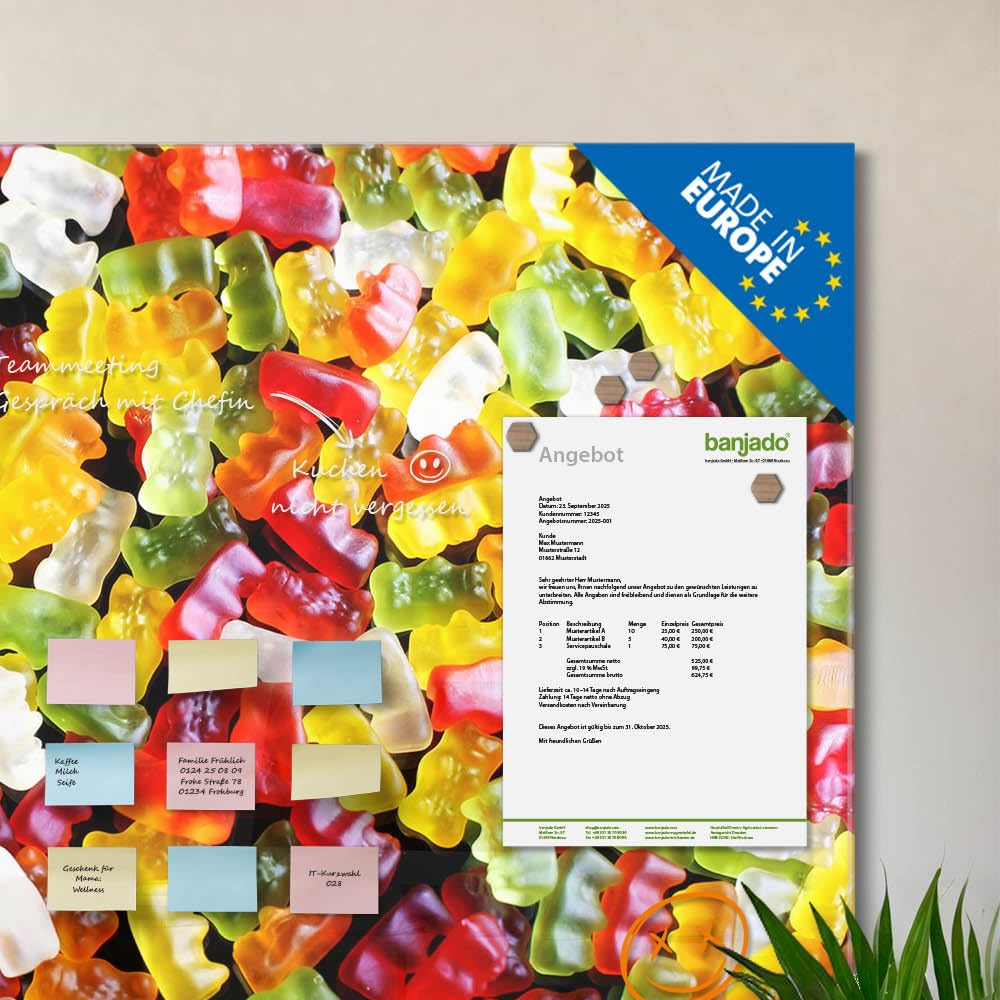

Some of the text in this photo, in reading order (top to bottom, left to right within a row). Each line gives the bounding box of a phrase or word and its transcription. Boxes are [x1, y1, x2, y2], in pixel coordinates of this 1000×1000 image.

[114, 391, 163, 411] mit
[172, 389, 255, 411] Chefin
[705, 432, 789, 457] banjado
[539, 446, 624, 466] Angebot
[292, 457, 388, 478] Kuchen
[271, 500, 469, 521] nicht vergessen
[54, 758, 79, 767] Kaffee
[178, 757, 209, 765] Familie
[57, 778, 77, 787] Seife
[180, 778, 242, 788] Frohe Straße 78
[178, 788, 245, 797] 01234 Frohburg
[62, 864, 115, 874] Geschenk für
[72, 885, 105, 894] Wellness
